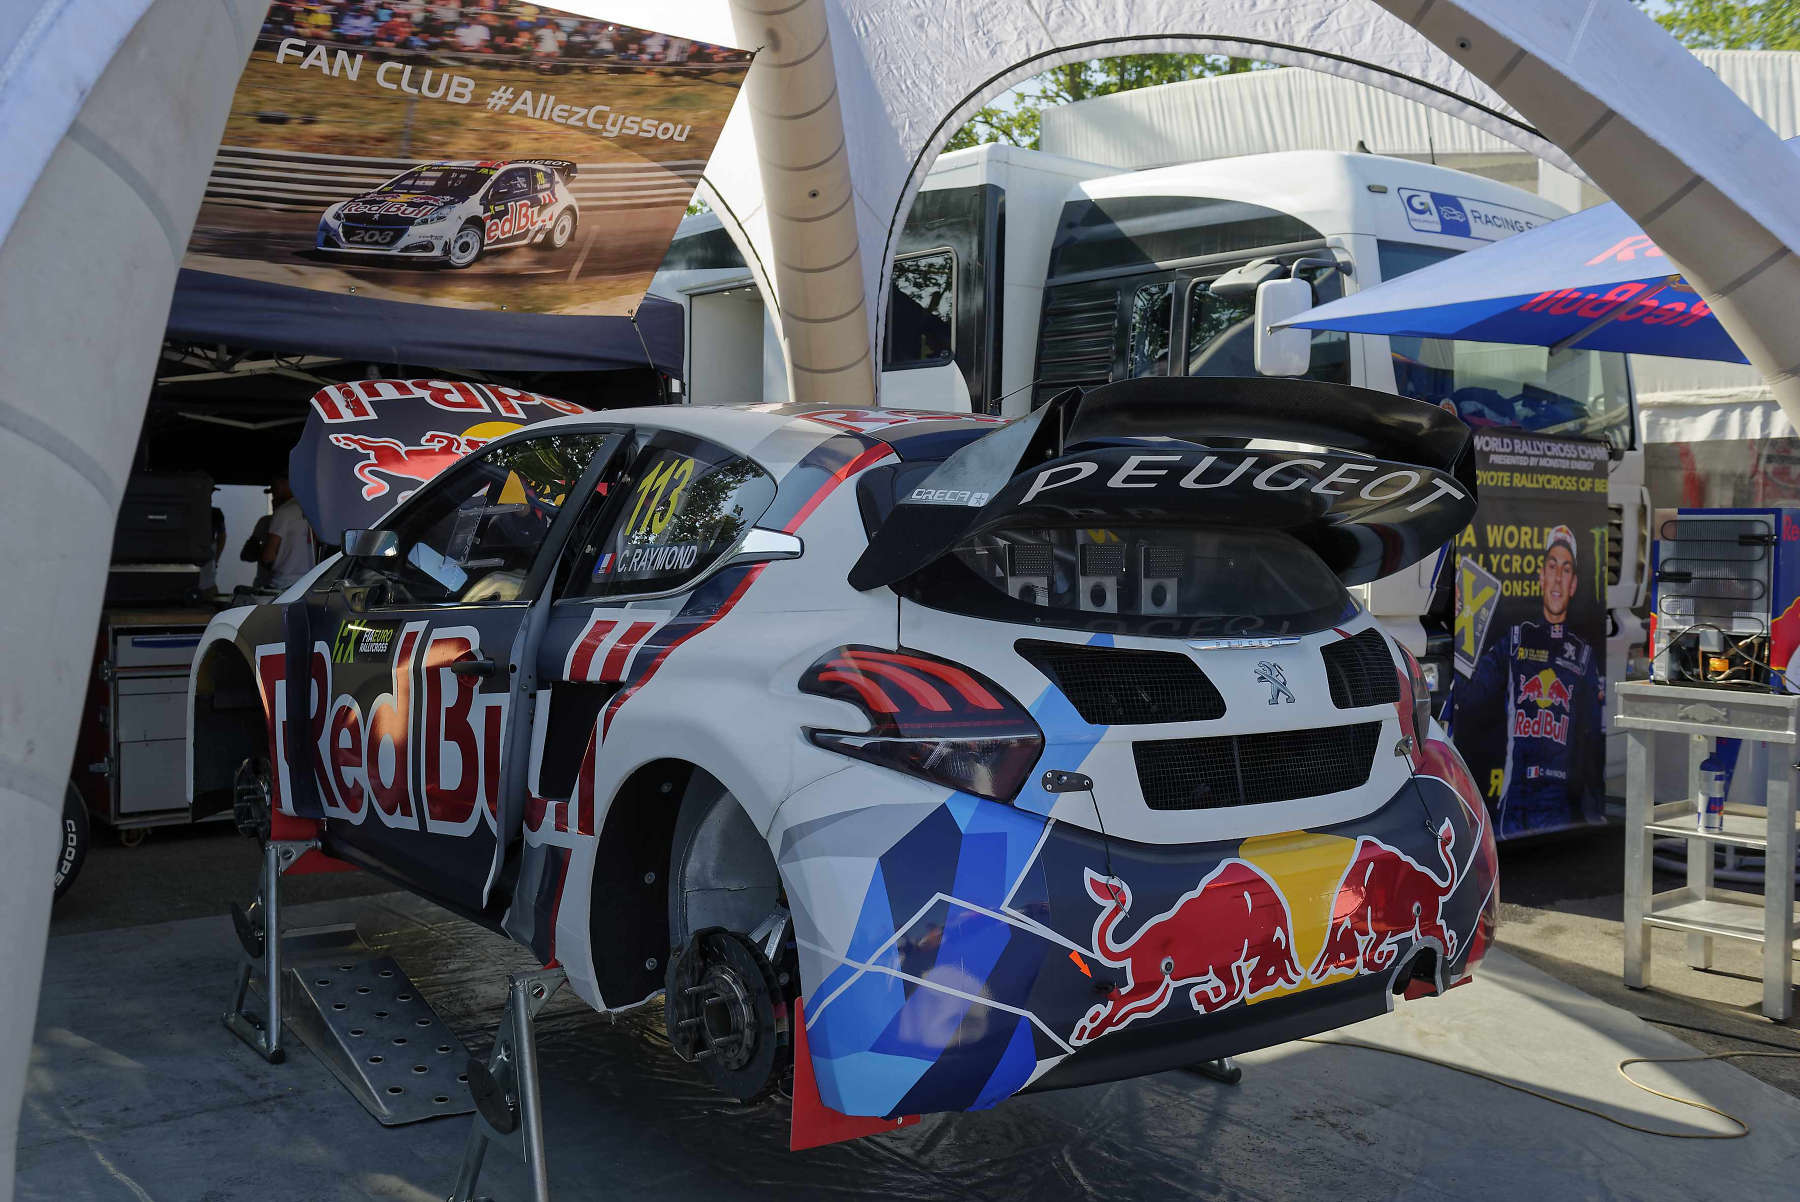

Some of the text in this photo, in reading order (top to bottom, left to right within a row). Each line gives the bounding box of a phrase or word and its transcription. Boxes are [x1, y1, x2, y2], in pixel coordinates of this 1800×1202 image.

[275, 37, 692, 142] FAN CLUB #AllezCyssou
[383, 203, 437, 218] Bull
[1470, 209, 1525, 233] RACING
[349, 230, 395, 244] 208
[1474, 435, 1512, 451] WORLD
[1513, 439, 1578, 458] RALLYCROSS
[1019, 455, 1466, 513] PEUGEOT
[1512, 472, 1578, 491] RALLYCROSS
[1578, 477, 1593, 492] OF
[624, 458, 695, 536] 113
[629, 545, 698, 572] RAYMOND
[1514, 709, 1569, 746] Red Bull
